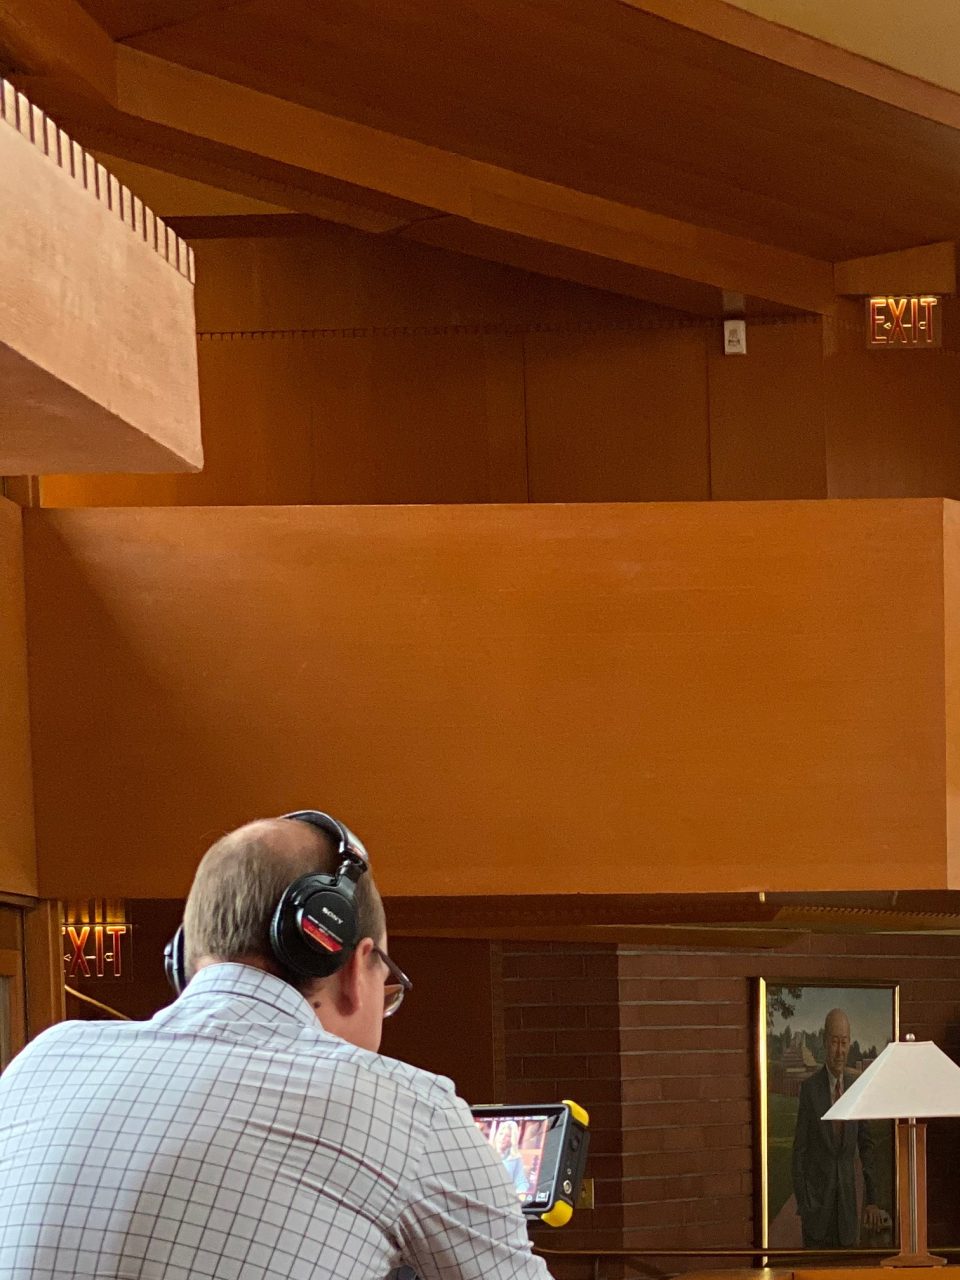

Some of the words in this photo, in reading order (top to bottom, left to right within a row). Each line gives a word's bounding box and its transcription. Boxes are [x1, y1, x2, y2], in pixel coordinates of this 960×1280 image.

[869, 297, 938, 344] EXIT
[322, 907, 344, 925] SONY
[62, 925, 126, 977] XIT
